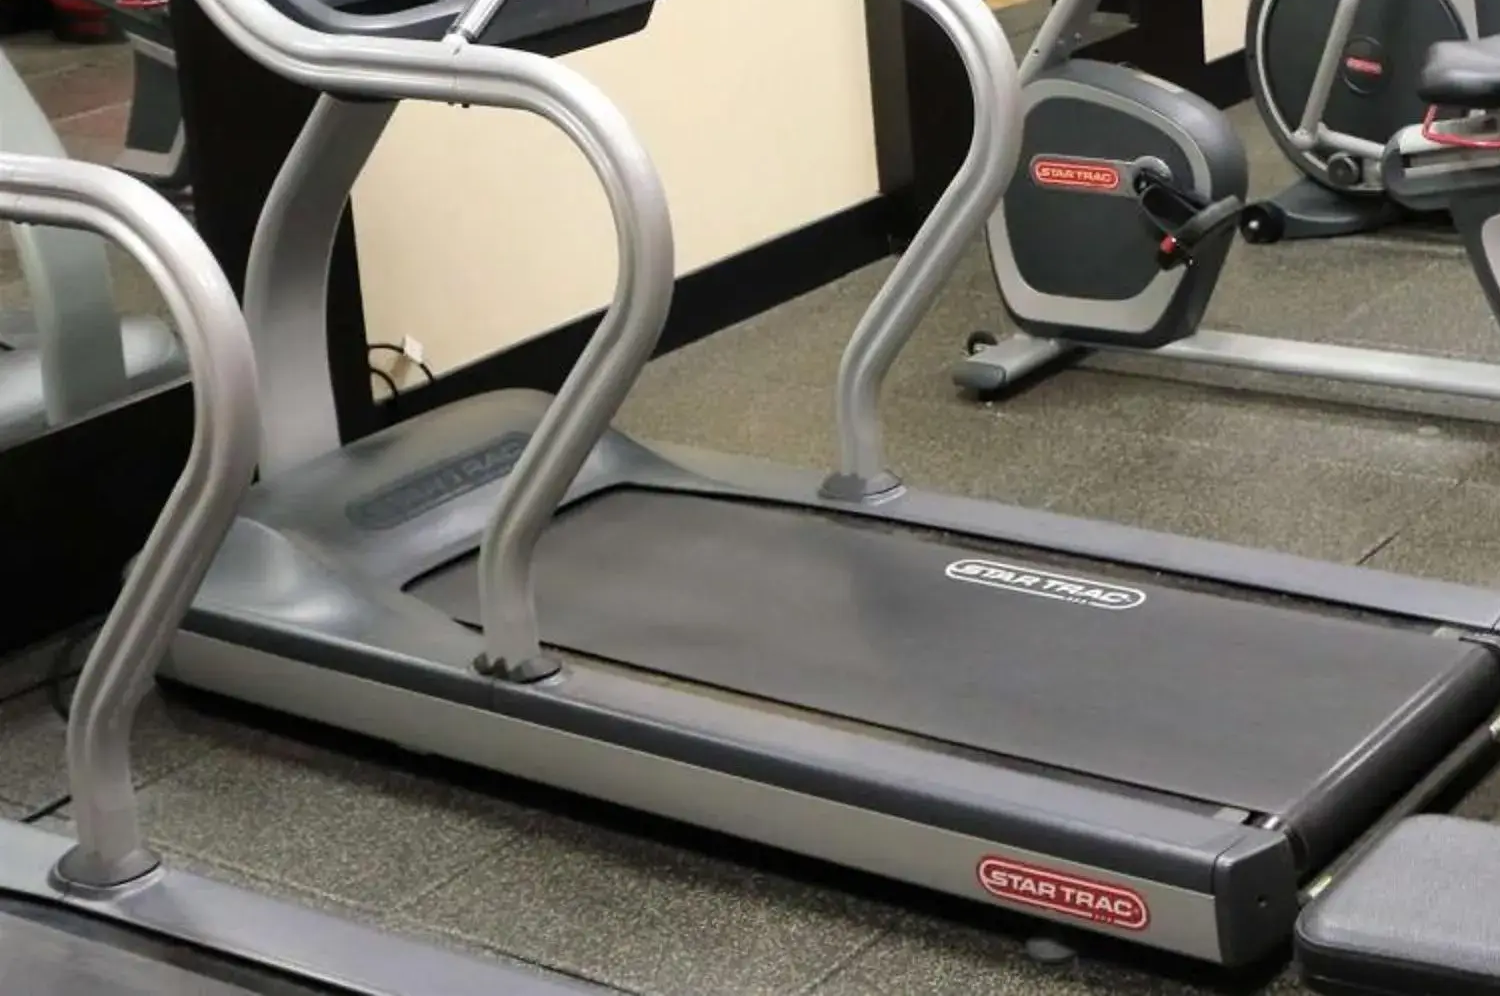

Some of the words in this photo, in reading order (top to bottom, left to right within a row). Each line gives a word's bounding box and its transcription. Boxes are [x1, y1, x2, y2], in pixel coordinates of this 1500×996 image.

[1040, 167, 1075, 179] STAR
[1077, 171, 1113, 183] TRAC
[957, 563, 1040, 586] STAR
[1042, 579, 1130, 603] TRAC
[986, 871, 1056, 898] STAR
[1060, 887, 1132, 917] TRAC
